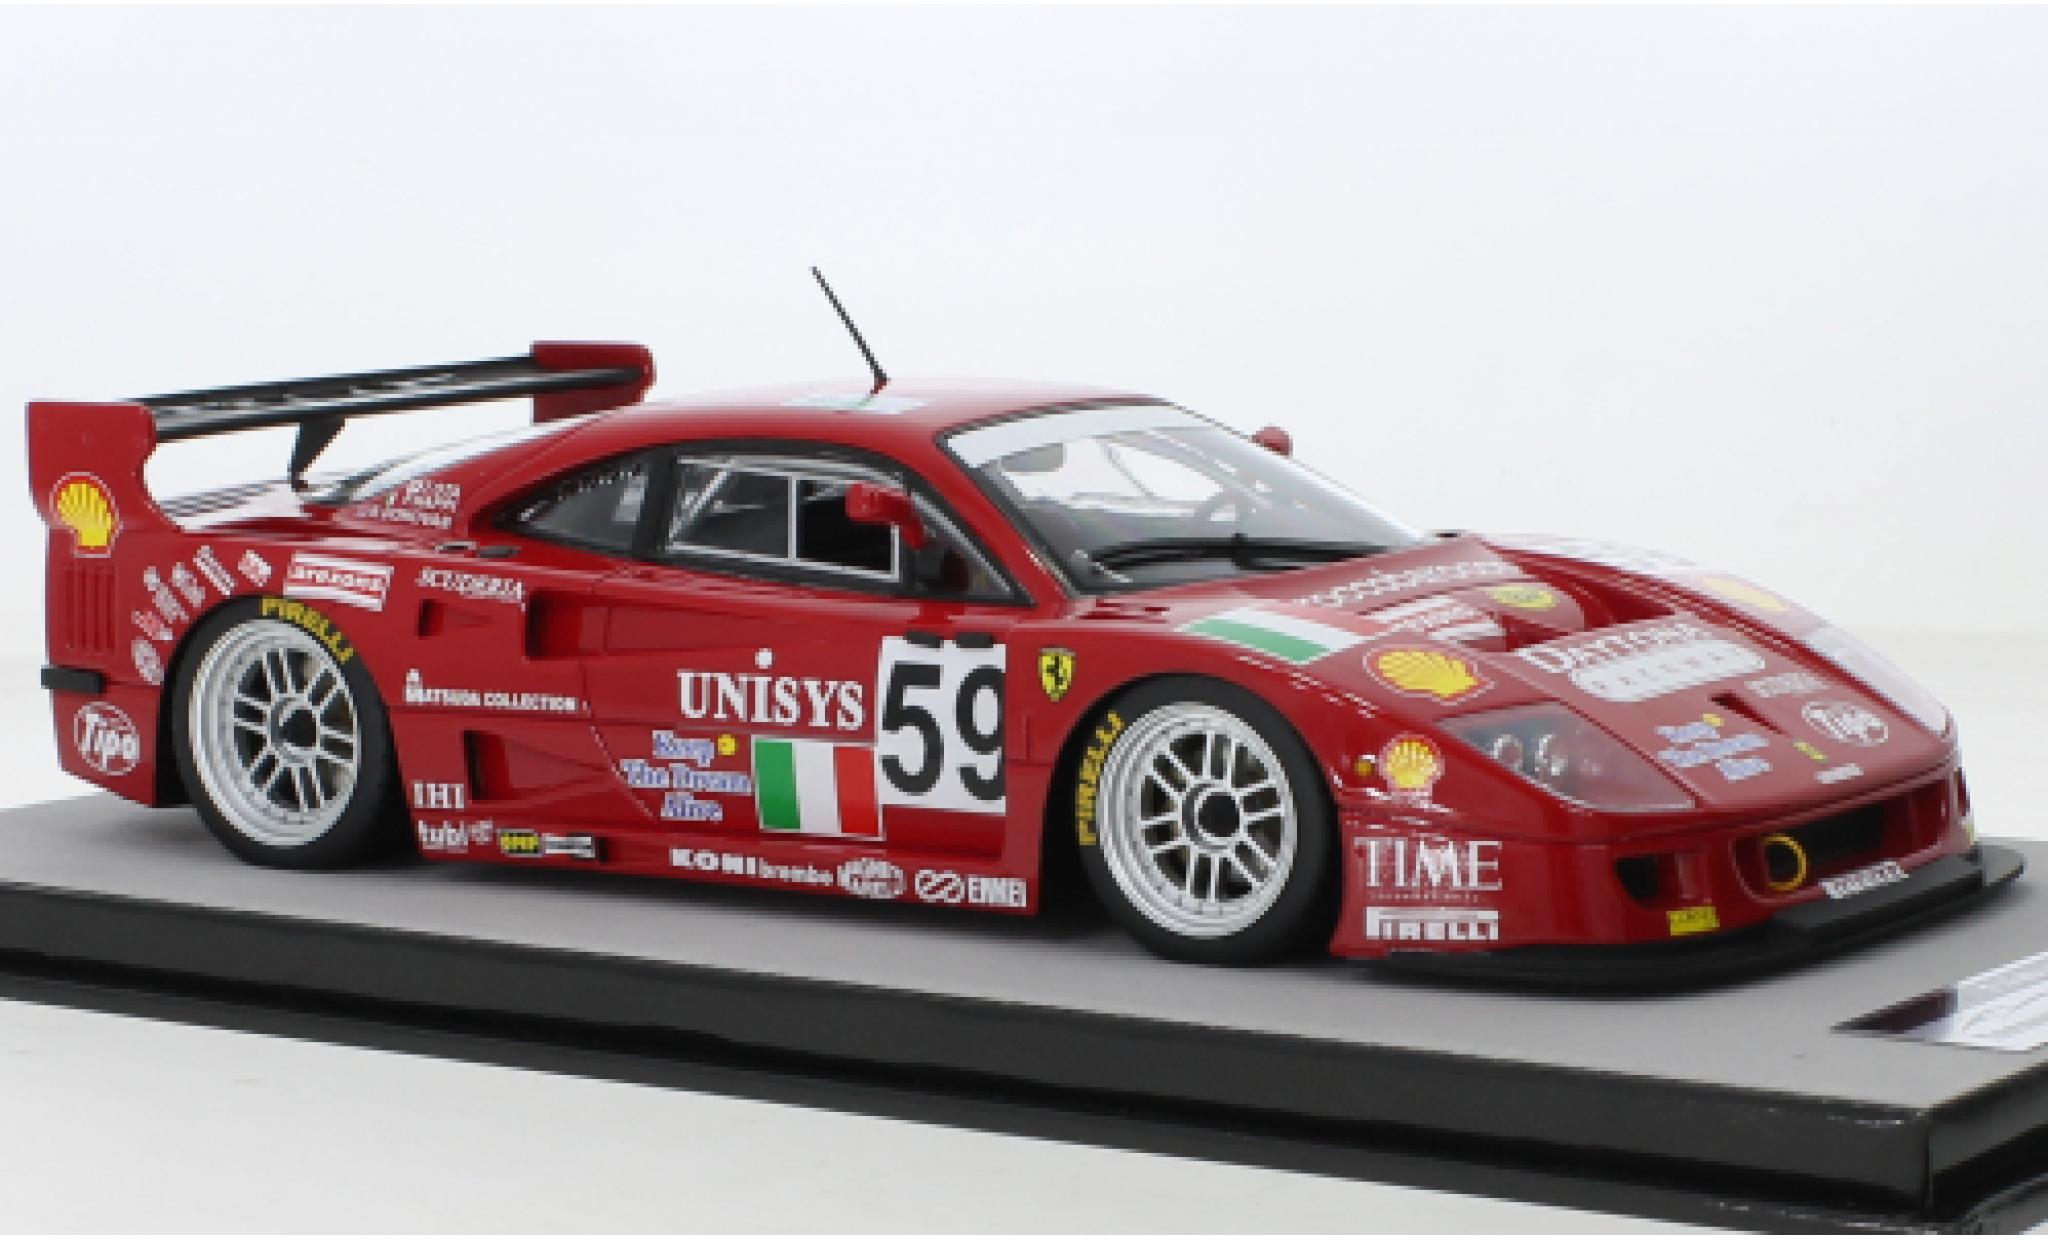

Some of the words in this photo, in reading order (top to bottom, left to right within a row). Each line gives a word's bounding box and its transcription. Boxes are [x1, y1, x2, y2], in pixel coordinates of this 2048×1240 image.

[261, 597, 353, 662] PIRELLI
[881, 660, 1003, 802] 59
[413, 781, 465, 810] IHI
[620, 758, 669, 788] The
[669, 763, 752, 796] Dream
[1075, 711, 1125, 846] PIRELLI
[669, 847, 757, 876] KONI
[758, 856, 834, 887] brembo
[1353, 837, 1503, 891] TIME
[1366, 907, 1499, 941] PIRELLI
